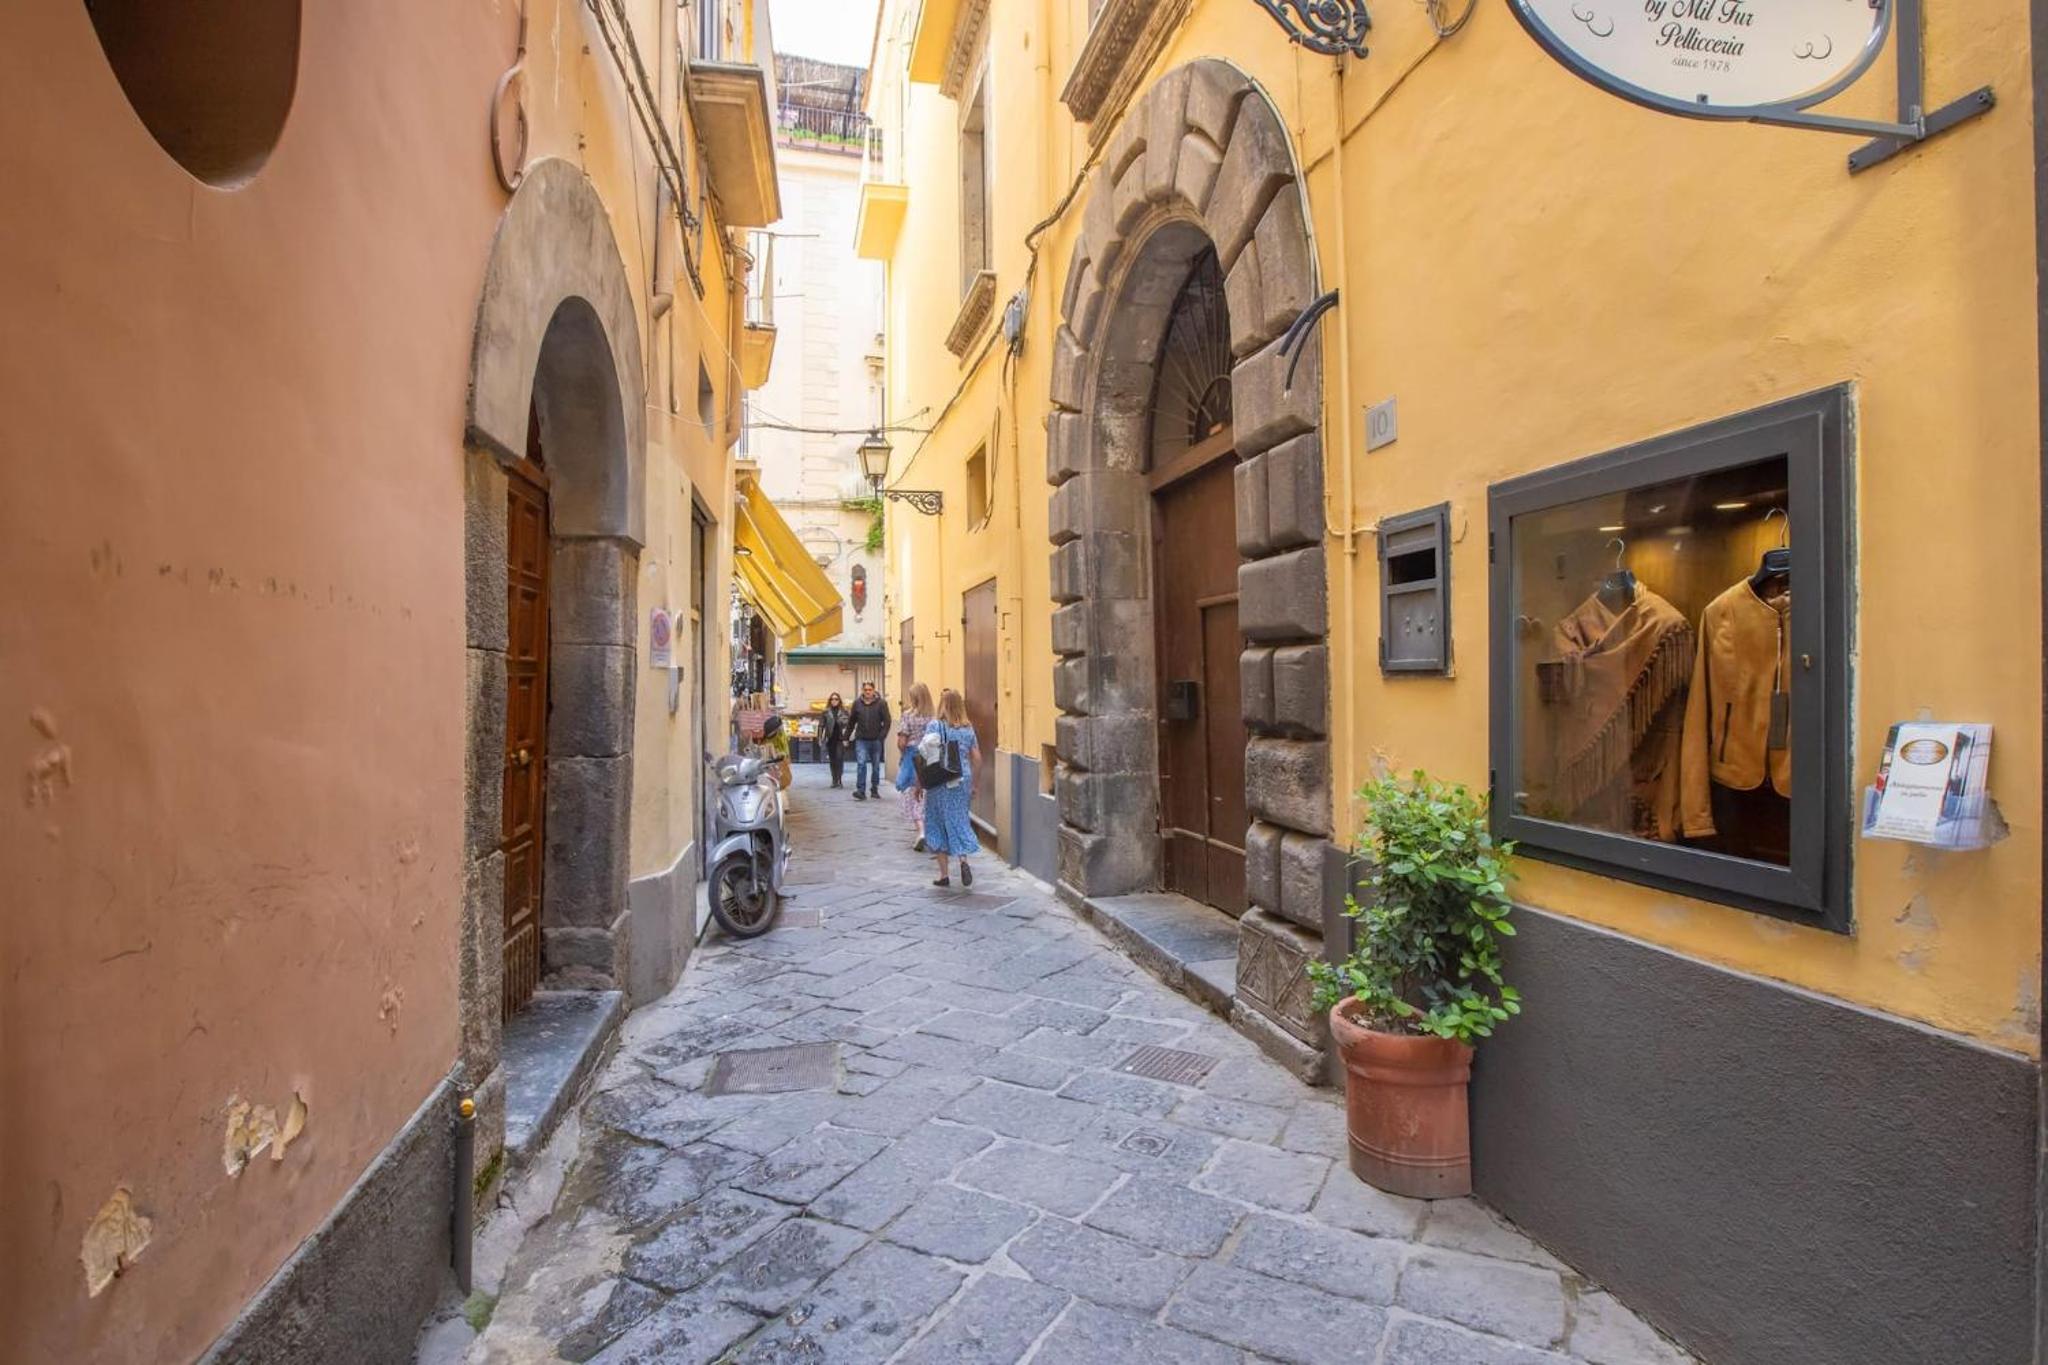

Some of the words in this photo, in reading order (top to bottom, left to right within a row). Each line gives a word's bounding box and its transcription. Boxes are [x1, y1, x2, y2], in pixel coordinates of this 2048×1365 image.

[1644, 0, 1667, 22] by
[1672, 0, 1716, 21] Mil
[1718, 0, 1754, 26] Fur
[1655, 22, 1745, 56] Pellicceria
[1672, 58, 1699, 68] since
[1703, 59, 1730, 72] 1978
[1371, 409, 1388, 438] 10
